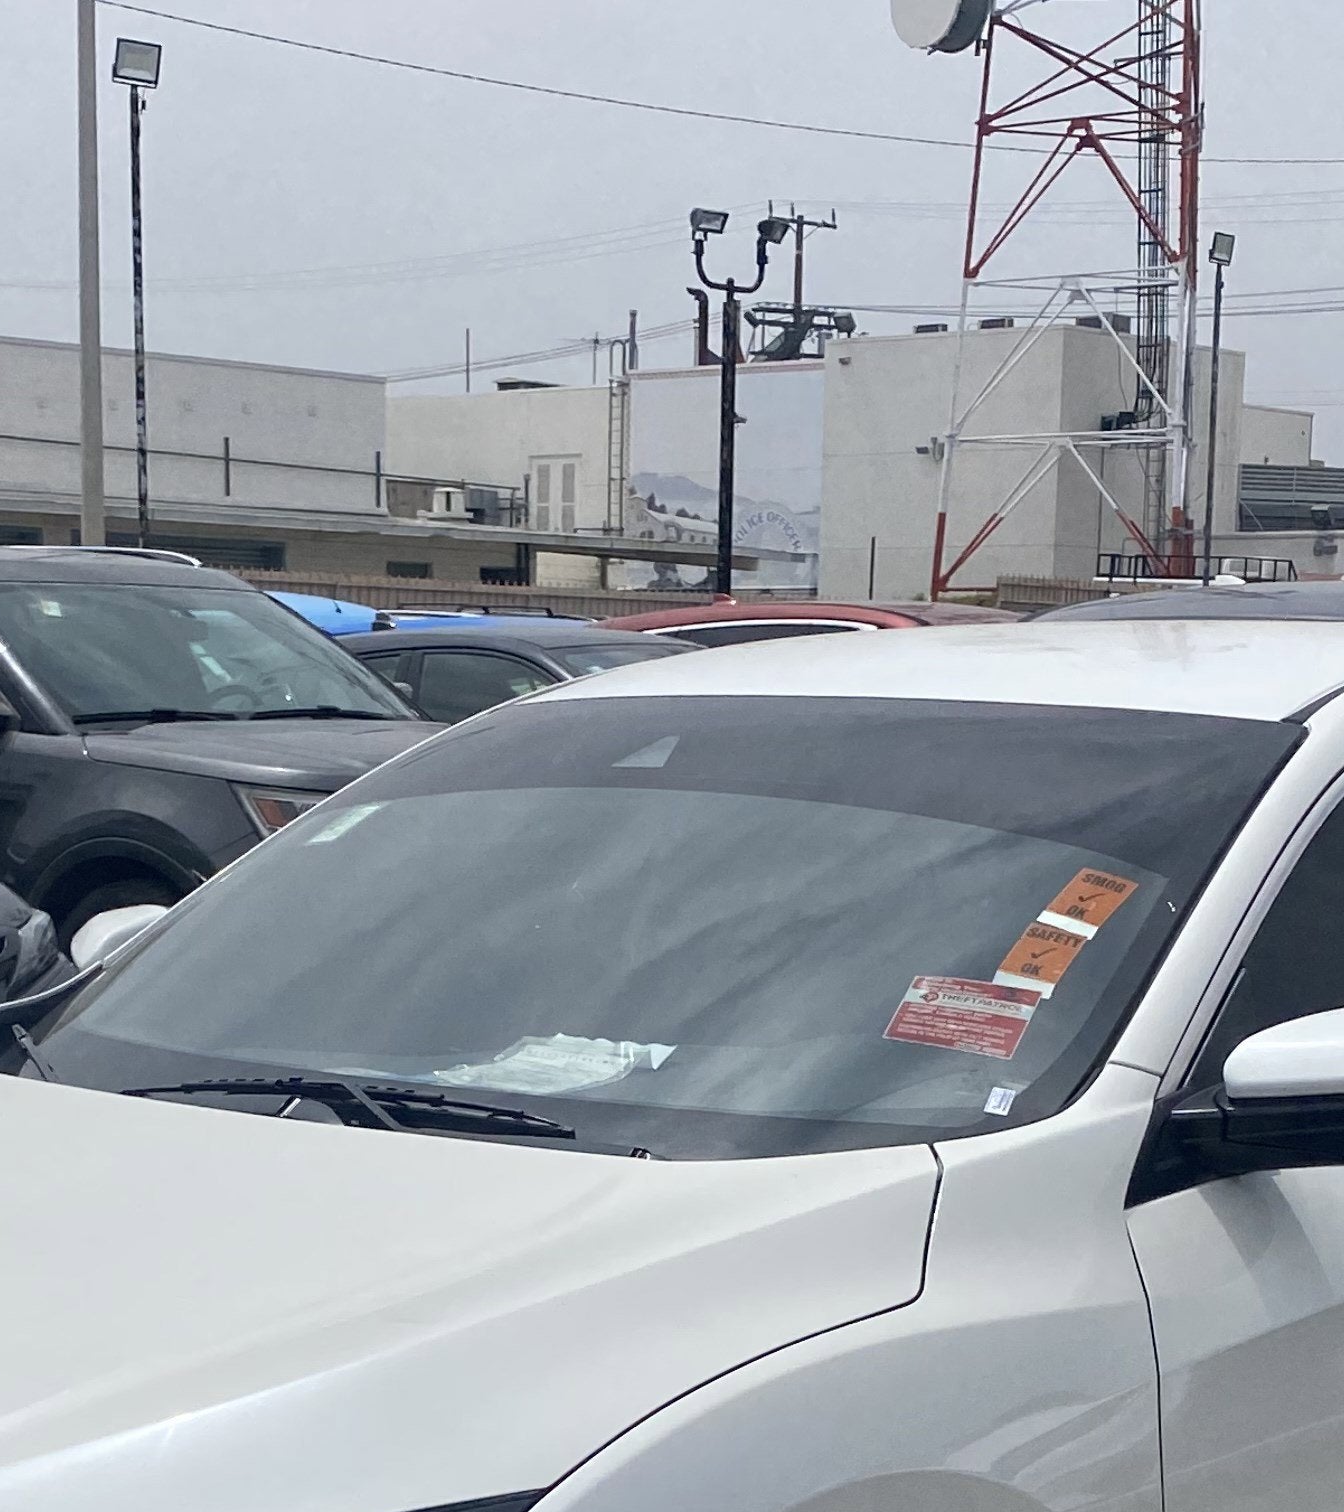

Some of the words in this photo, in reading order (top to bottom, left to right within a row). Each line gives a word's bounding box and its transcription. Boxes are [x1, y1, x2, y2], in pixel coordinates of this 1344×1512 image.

[734, 512, 764, 543] OLICE
[766, 511, 802, 551] OFFICER
[1066, 904, 1090, 920] OK
[1026, 926, 1082, 949] SAFETY
[1020, 962, 1044, 976] OK
